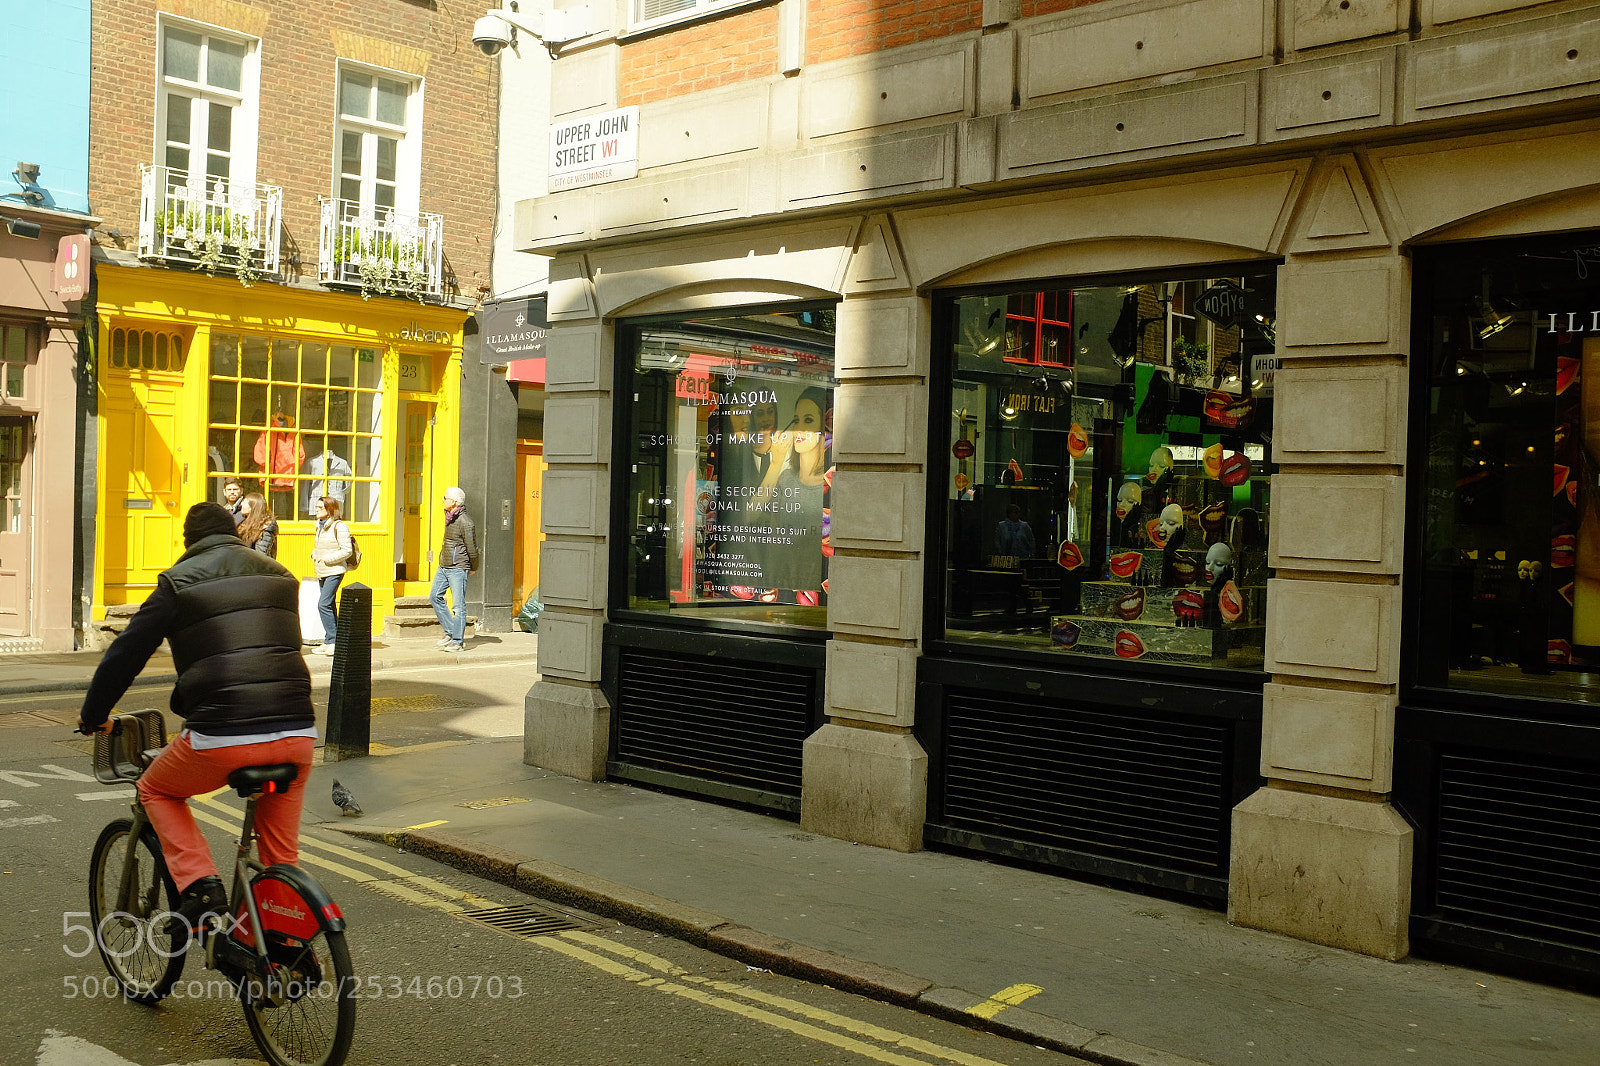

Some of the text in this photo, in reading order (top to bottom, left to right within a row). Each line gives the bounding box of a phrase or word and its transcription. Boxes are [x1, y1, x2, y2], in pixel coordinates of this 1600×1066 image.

[556, 114, 629, 146] UPPER JOHN
[555, 138, 618, 167] STREET W1
[574, 169, 613, 183] WESTMINSTER
[400, 320, 451, 345] albam
[486, 330, 548, 345] ILLAMASQU
[402, 364, 417, 378] 23
[686, 391, 778, 407] ILLAMASQUA
[706, 433, 722, 445] OF
[729, 432, 764, 444] MAKE
[771, 433, 788, 444] UP
[795, 432, 821, 443] ART
[726, 486, 777, 498] SECRETS
[785, 487, 800, 498] OF
[746, 501, 804, 513] MAKE-UP.
[734, 525, 772, 535] DESIGNED
[776, 526, 786, 535] TO
[789, 527, 807, 536] SUIT
[730, 535, 746, 543] AND
[750, 536, 793, 545] INTERESTS.
[269, 900, 305, 920] Santander
